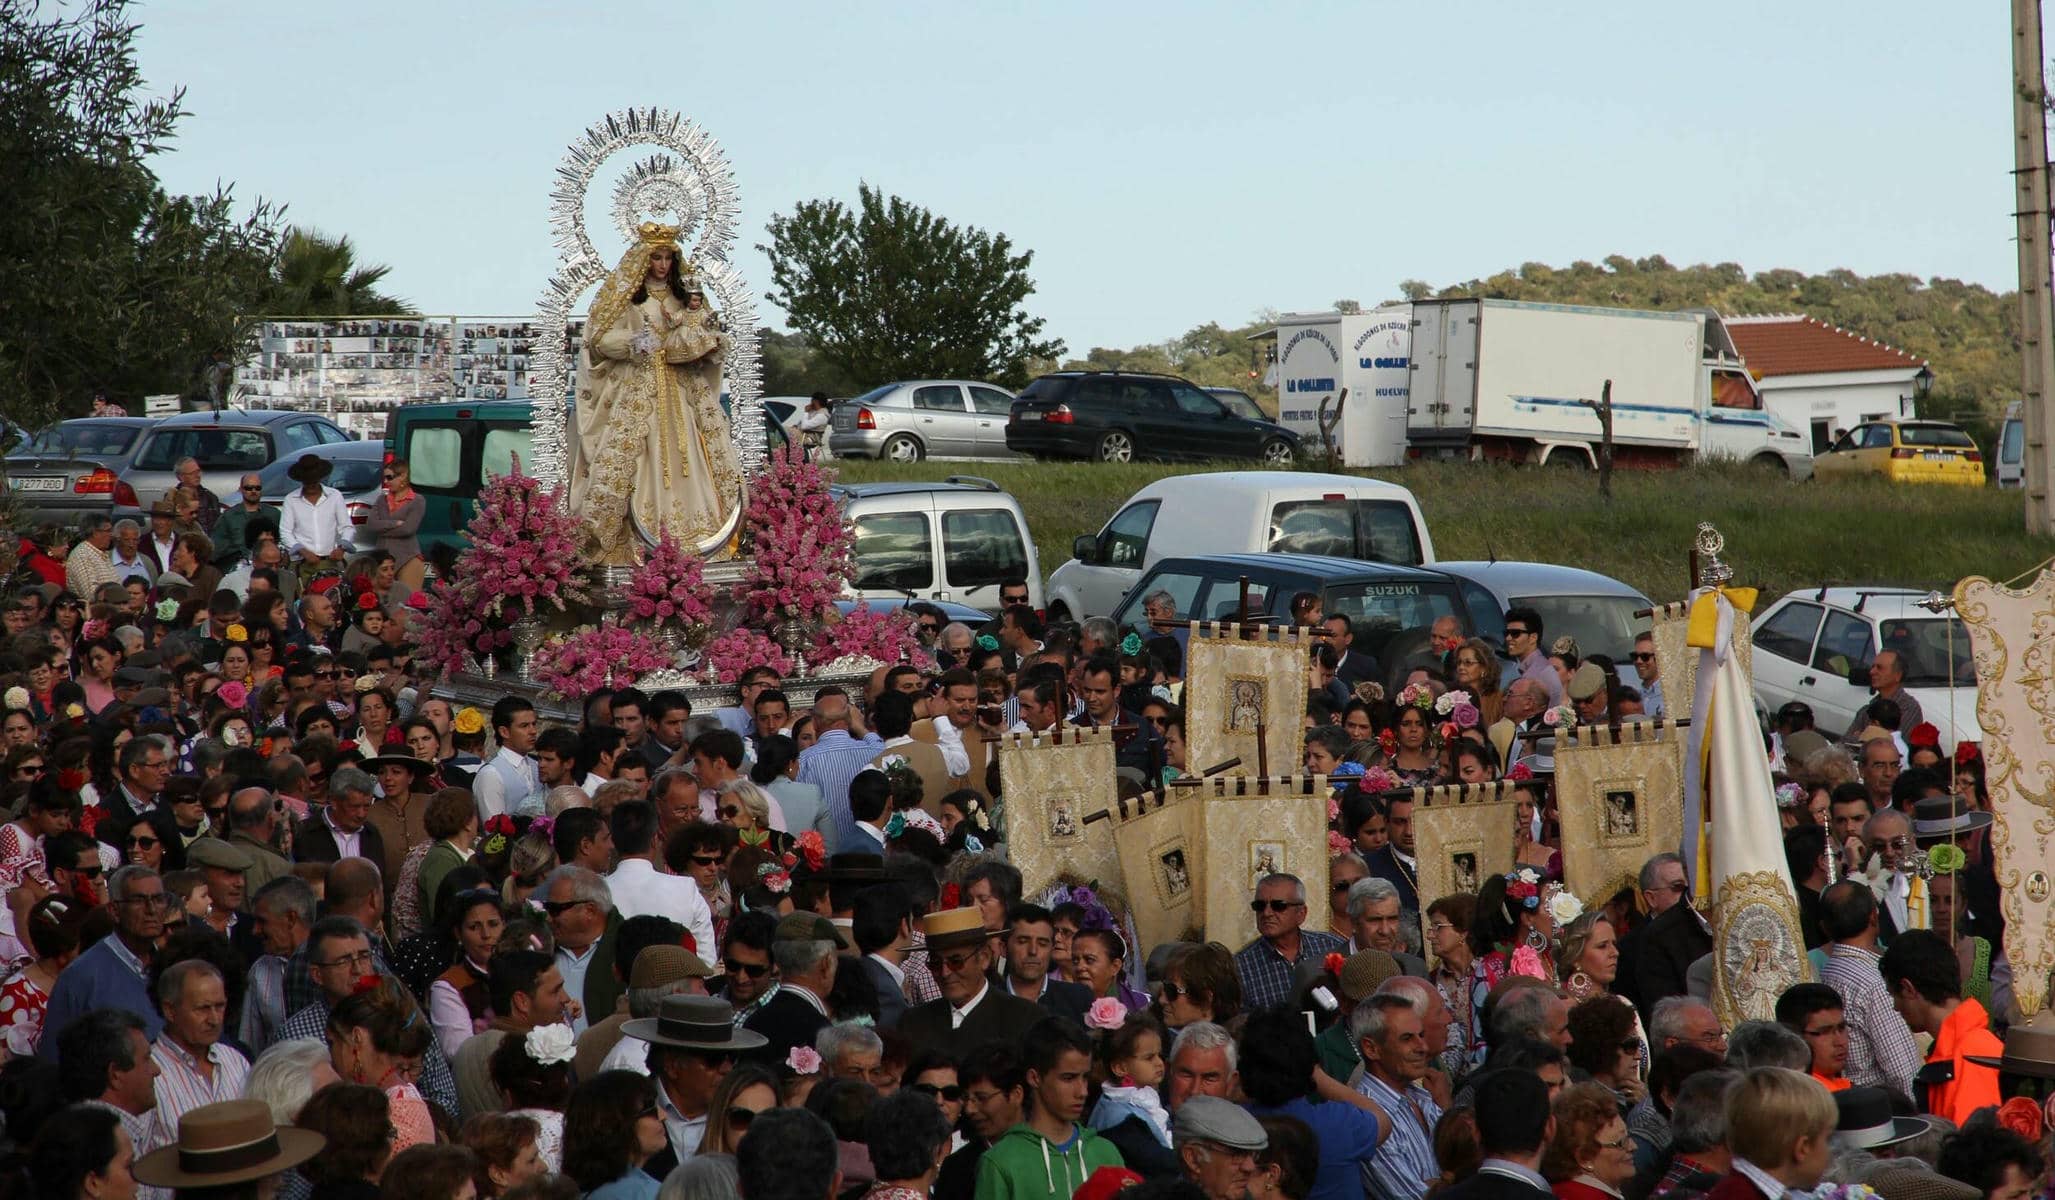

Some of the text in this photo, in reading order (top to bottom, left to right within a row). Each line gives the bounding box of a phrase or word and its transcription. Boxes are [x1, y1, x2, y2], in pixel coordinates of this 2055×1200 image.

[1360, 357, 1372, 369] LA
[1286, 379, 1296, 392] LA
[1365, 585, 1420, 596] SUZUKI
